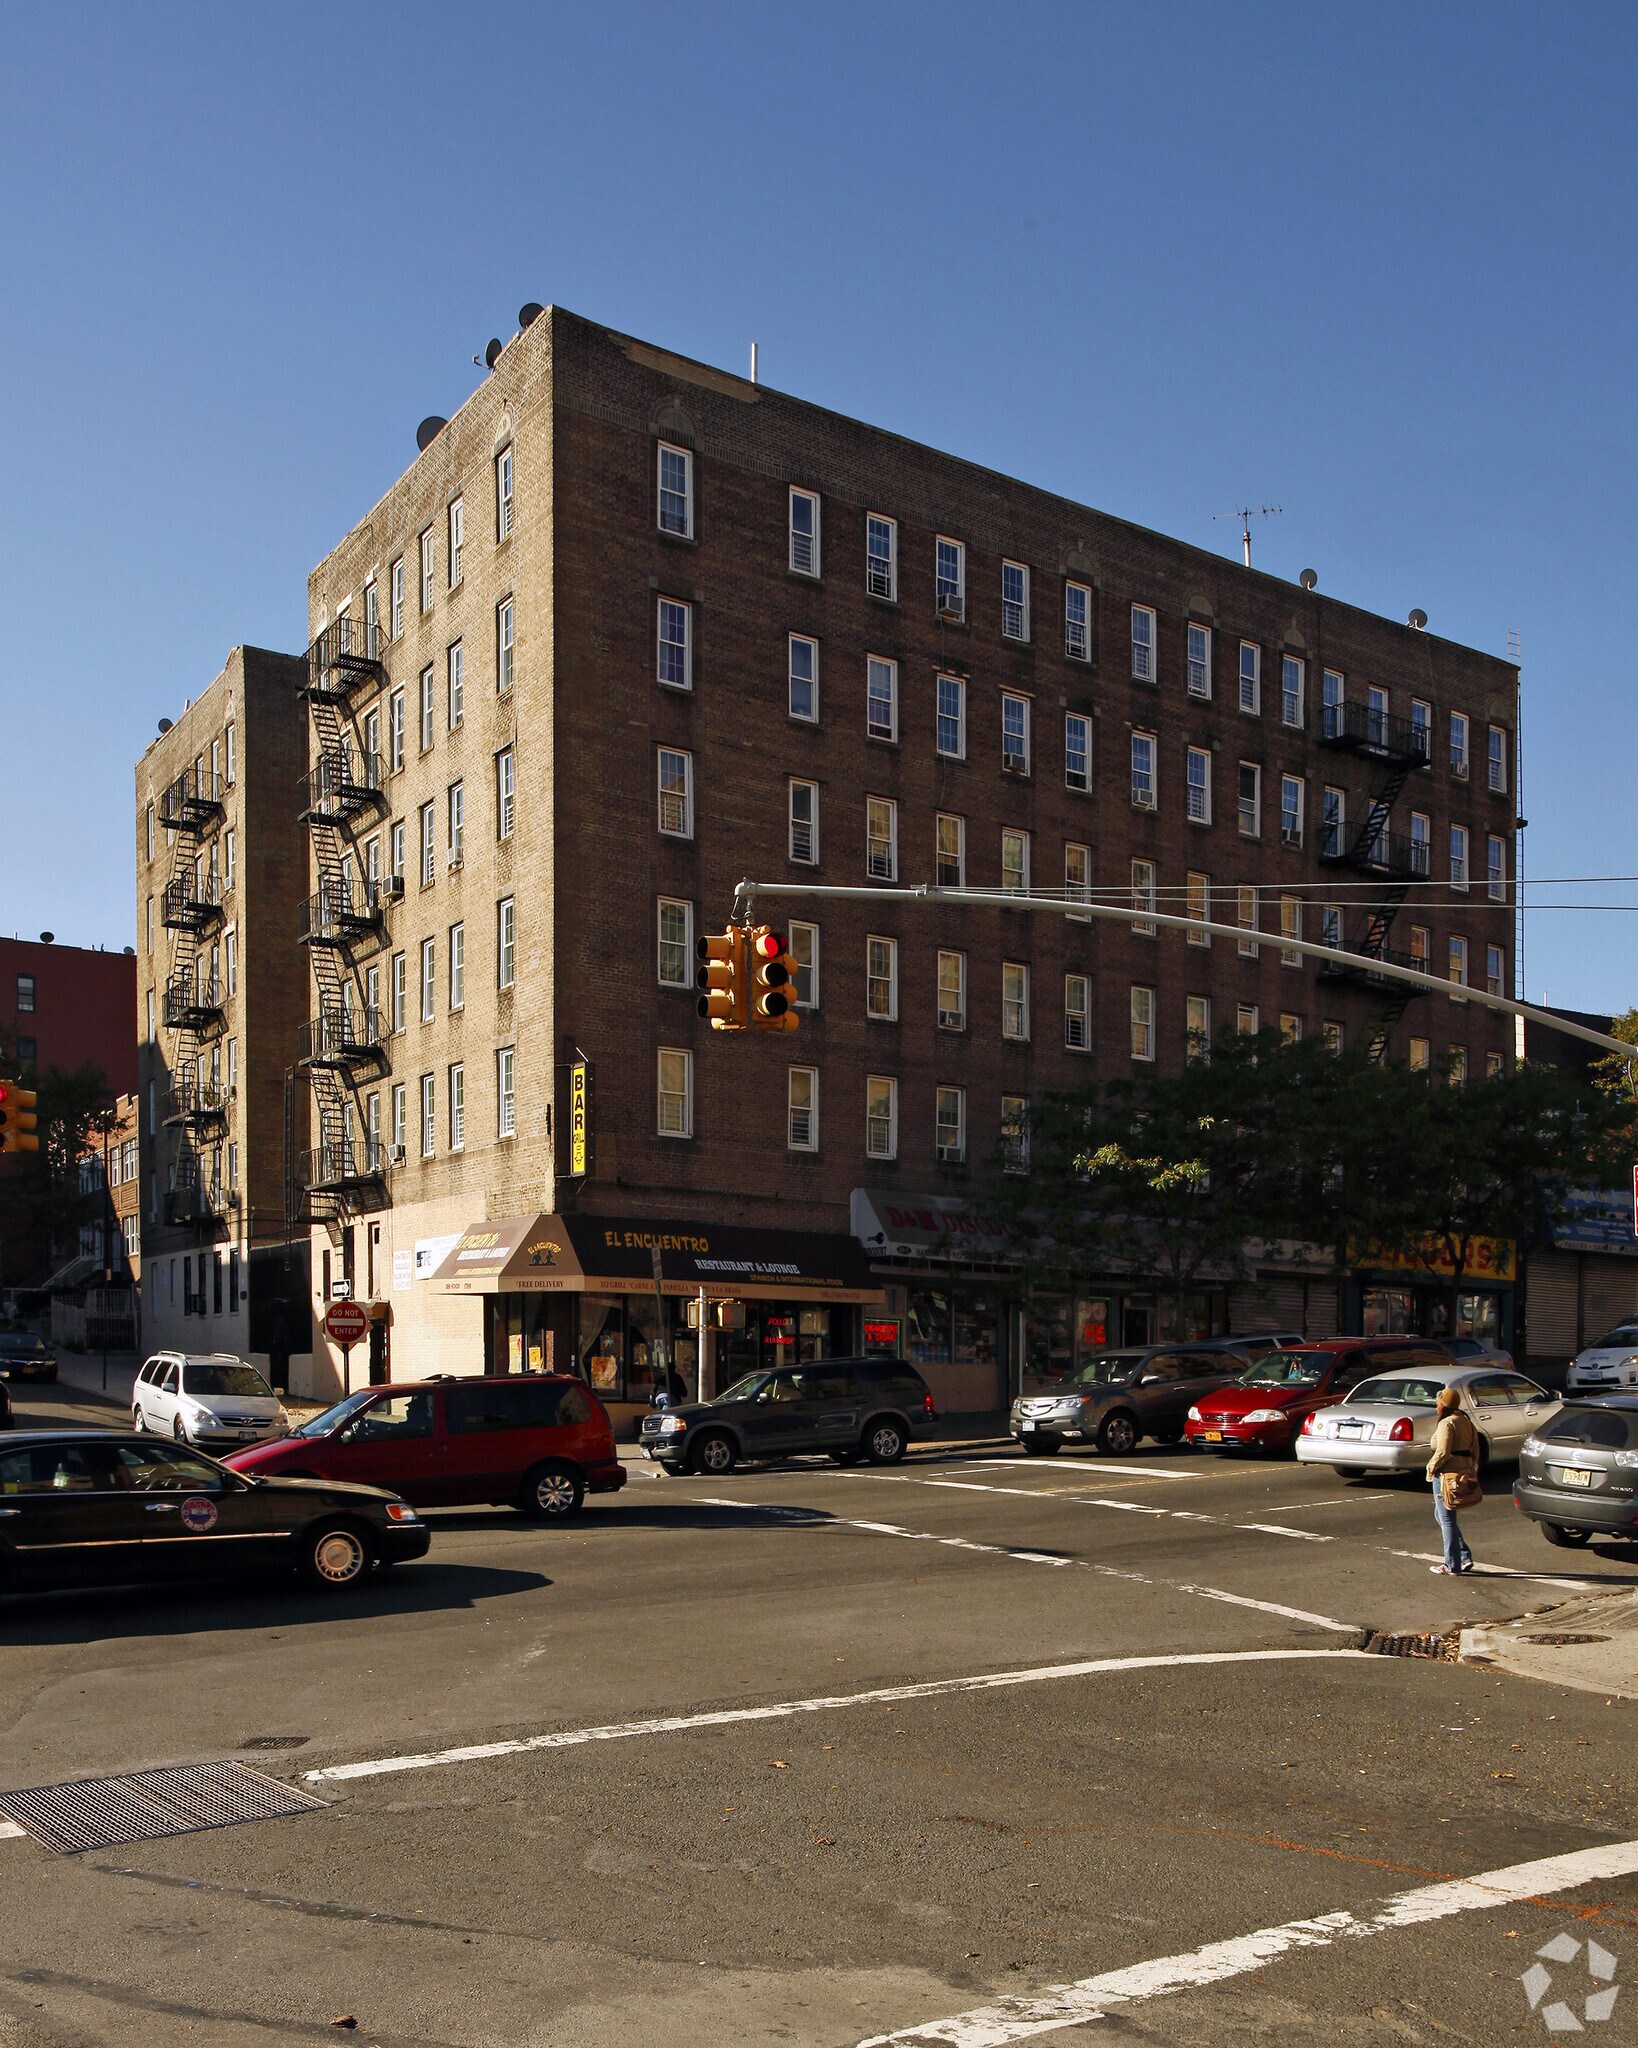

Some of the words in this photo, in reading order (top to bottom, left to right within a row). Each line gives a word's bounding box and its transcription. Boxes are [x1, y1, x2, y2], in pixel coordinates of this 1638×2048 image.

[574, 1073, 584, 1131] BAR
[604, 1230, 622, 1247] EL
[623, 1232, 710, 1253] ENCUENTRO
[694, 1258, 754, 1273] RESTAURANT
[755, 1262, 763, 1272] &
[763, 1262, 801, 1275] LOUNGE
[518, 1280, 533, 1288] FREE
[534, 1280, 564, 1288] DELIVERY
[827, 1279, 844, 1287] FOOD
[334, 1327, 358, 1335] ENTER
